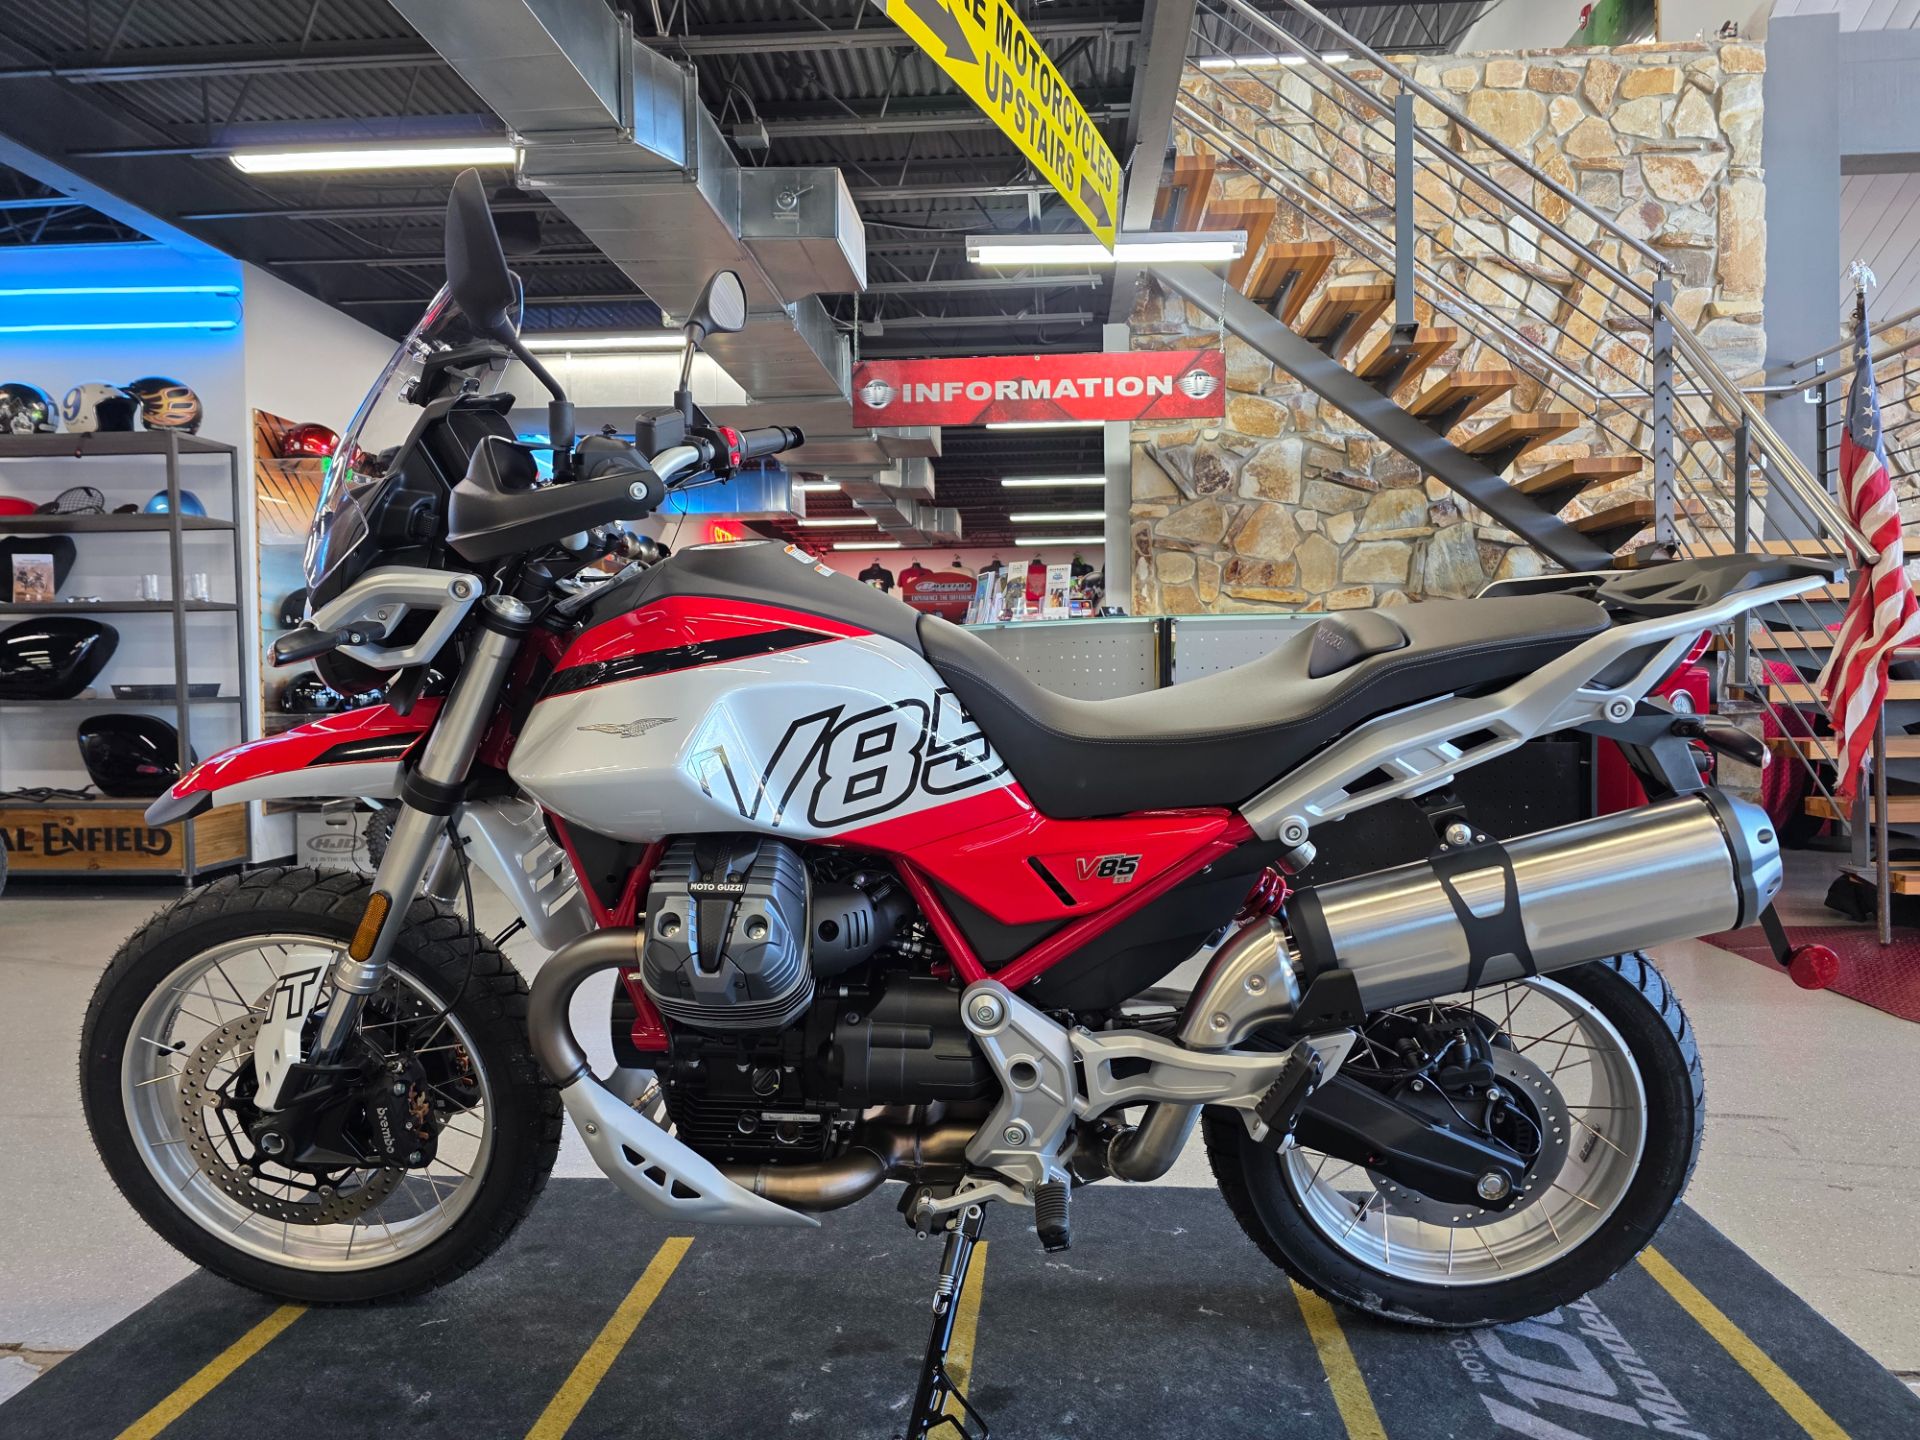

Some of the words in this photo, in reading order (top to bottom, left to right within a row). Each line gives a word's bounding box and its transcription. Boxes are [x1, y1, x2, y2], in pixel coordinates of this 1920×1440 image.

[984, 50, 1075, 192] UPSTAIRS
[995, 3, 1113, 193] MOTORCYCLES
[903, 375, 1173, 403] INFORMATION
[688, 688, 1008, 828] V85
[690, 883, 715, 891] MOTO
[717, 883, 743, 891] GUZZI
[1076, 854, 1143, 880] V85
[376, 1107, 395, 1153] brembo
